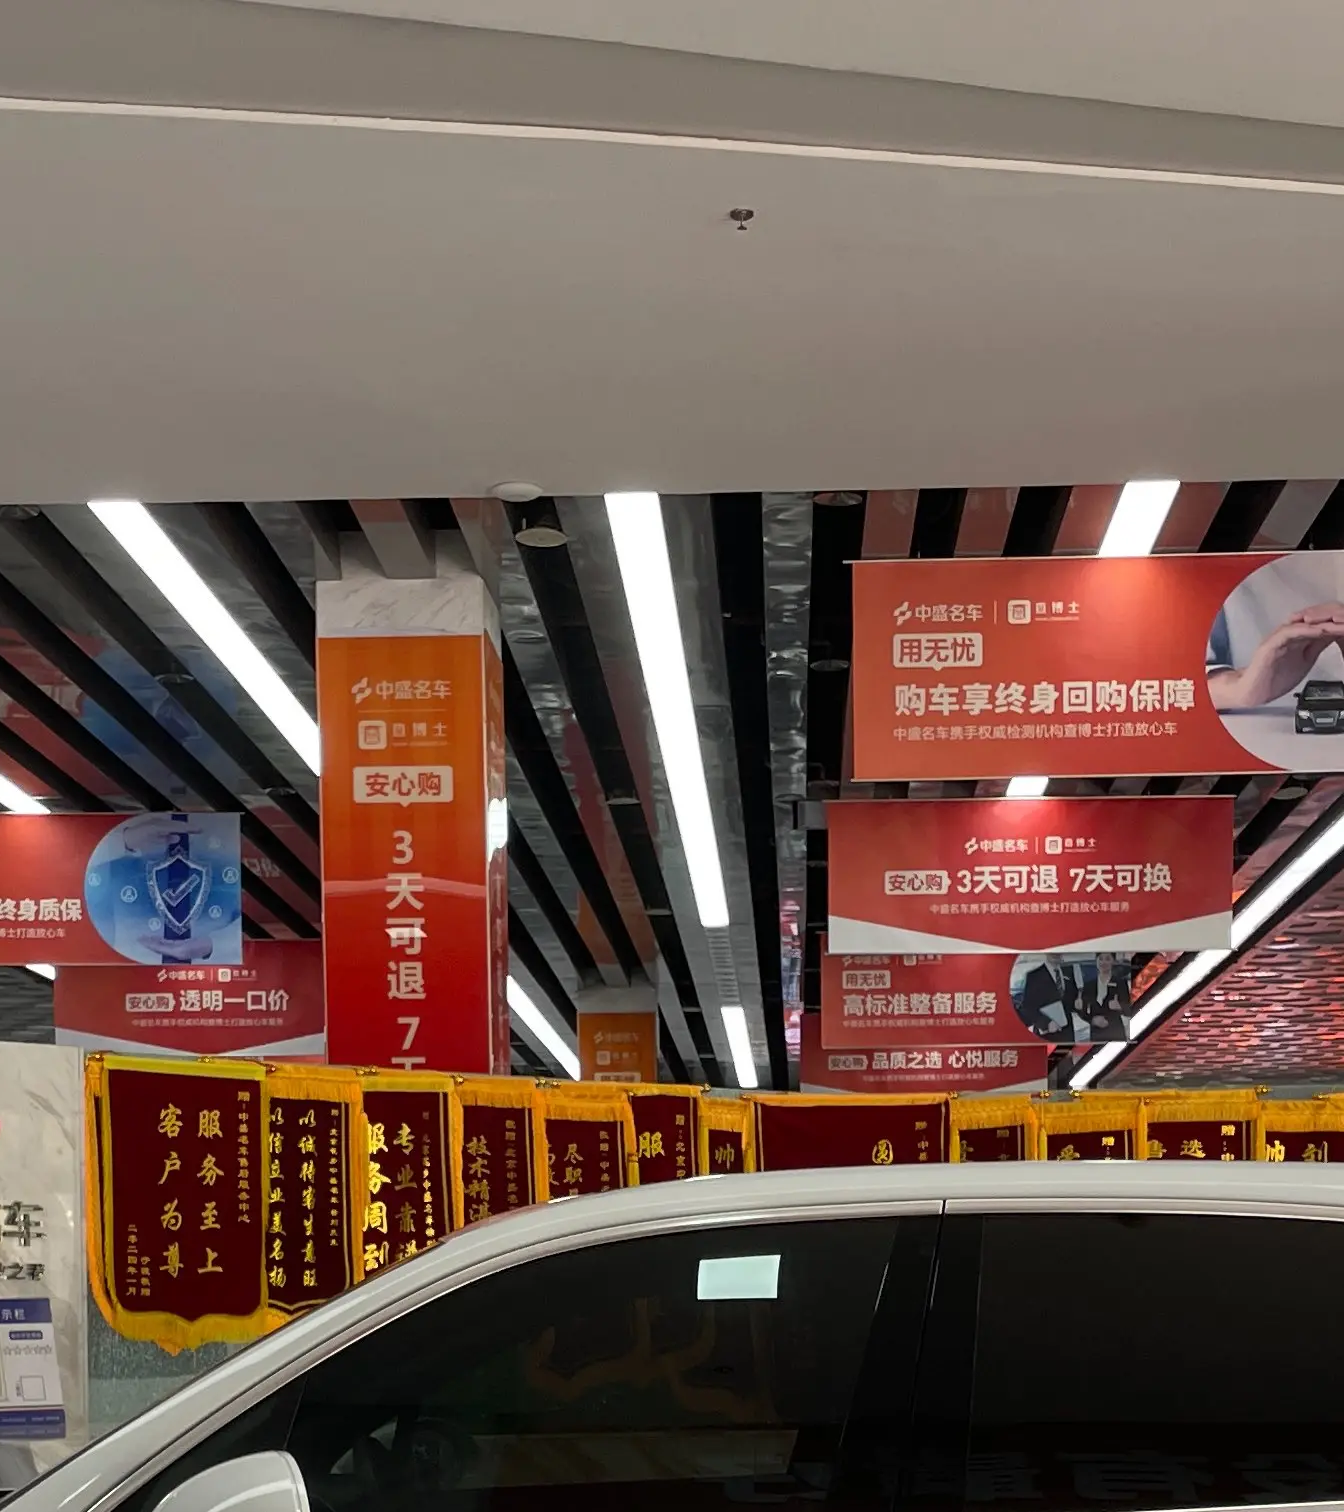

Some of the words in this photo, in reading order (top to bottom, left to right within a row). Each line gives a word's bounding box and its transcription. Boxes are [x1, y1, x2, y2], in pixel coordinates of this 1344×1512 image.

[915, 603, 983, 622] 中盛名车
[898, 638, 976, 663] 用无忧
[375, 679, 452, 700] 中盛名车
[894, 678, 1196, 716] 购车享终身回购保障
[365, 772, 442, 797] 安心购
[888, 873, 944, 892] 安心购
[956, 863, 1059, 895] 3天可退
[1068, 862, 1172, 893] 7天可换
[384, 829, 427, 1000] 3天可退
[180, 988, 290, 1013] 透明一口价
[158, 1102, 184, 1280] 客户为尊
[196, 1109, 225, 1275] 服务至上
